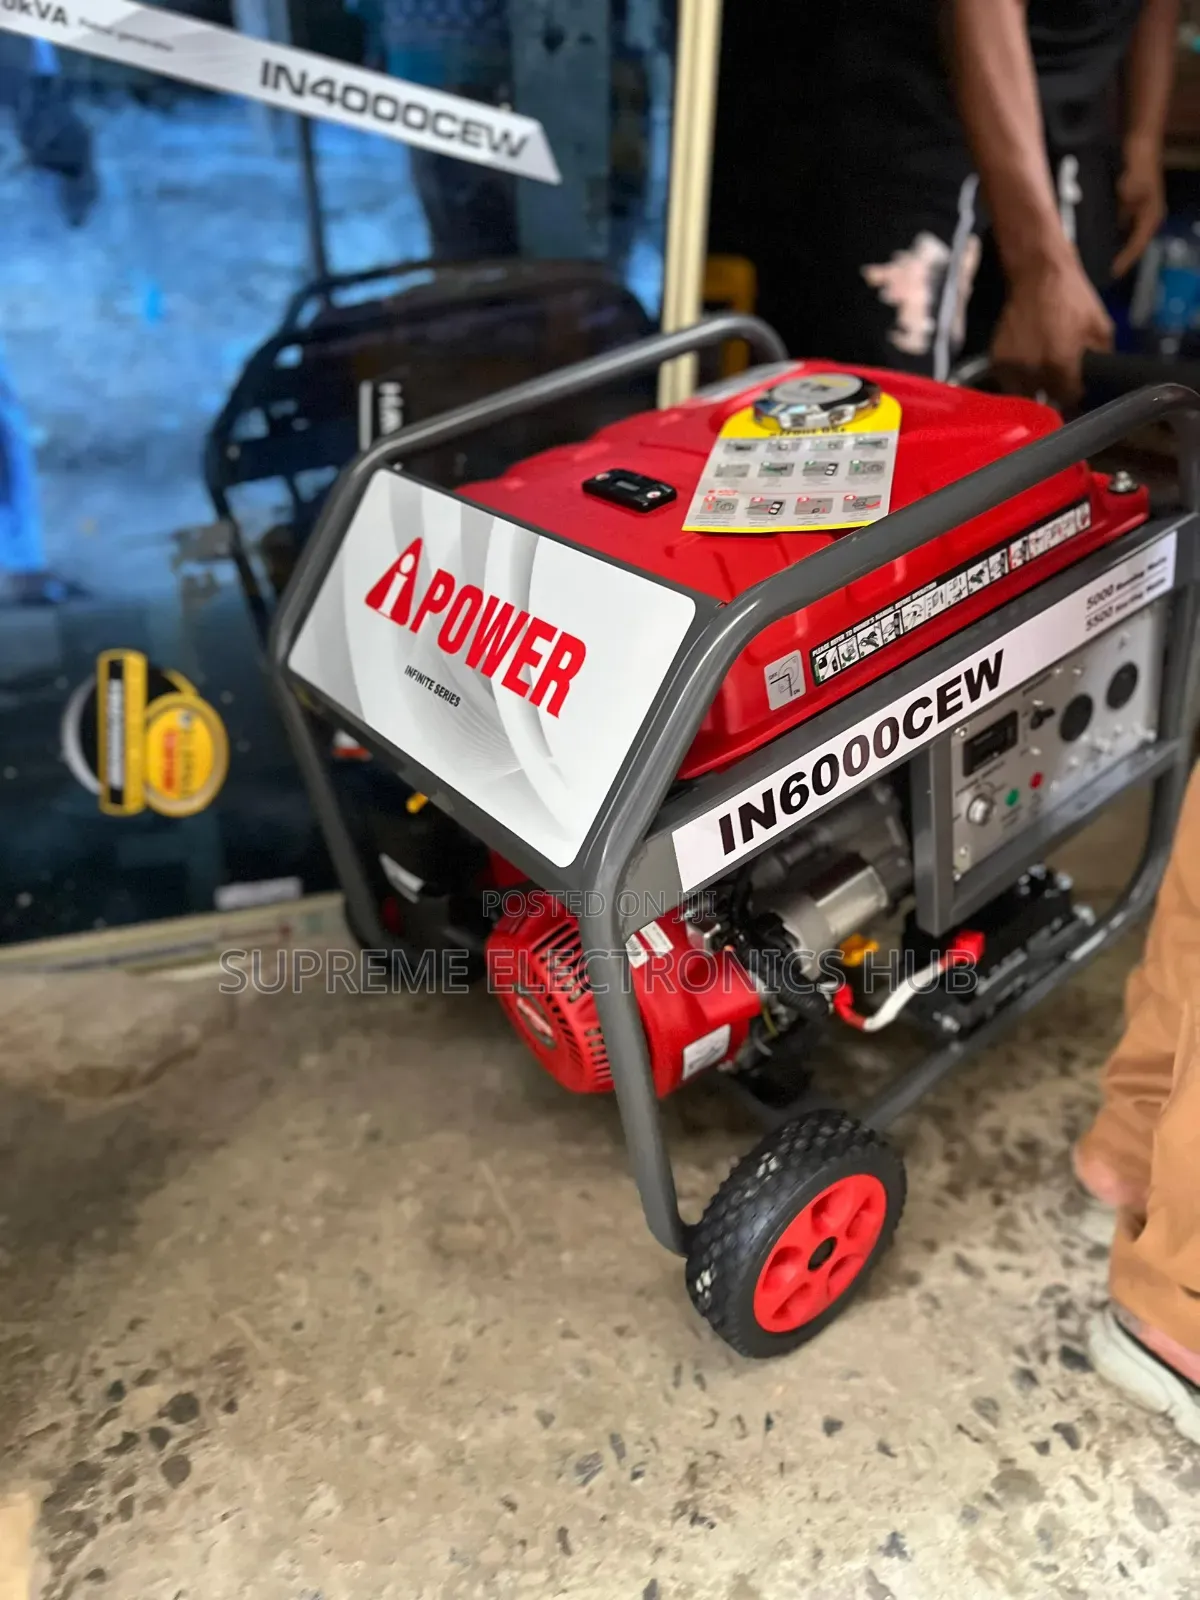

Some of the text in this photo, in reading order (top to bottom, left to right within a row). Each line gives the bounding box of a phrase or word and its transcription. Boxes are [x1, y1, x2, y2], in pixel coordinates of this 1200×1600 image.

[260, 59, 529, 158] IN4000CEW
[404, 664, 461, 707] INFINITE SERIES
[718, 648, 1004, 856] IN6000CEW
